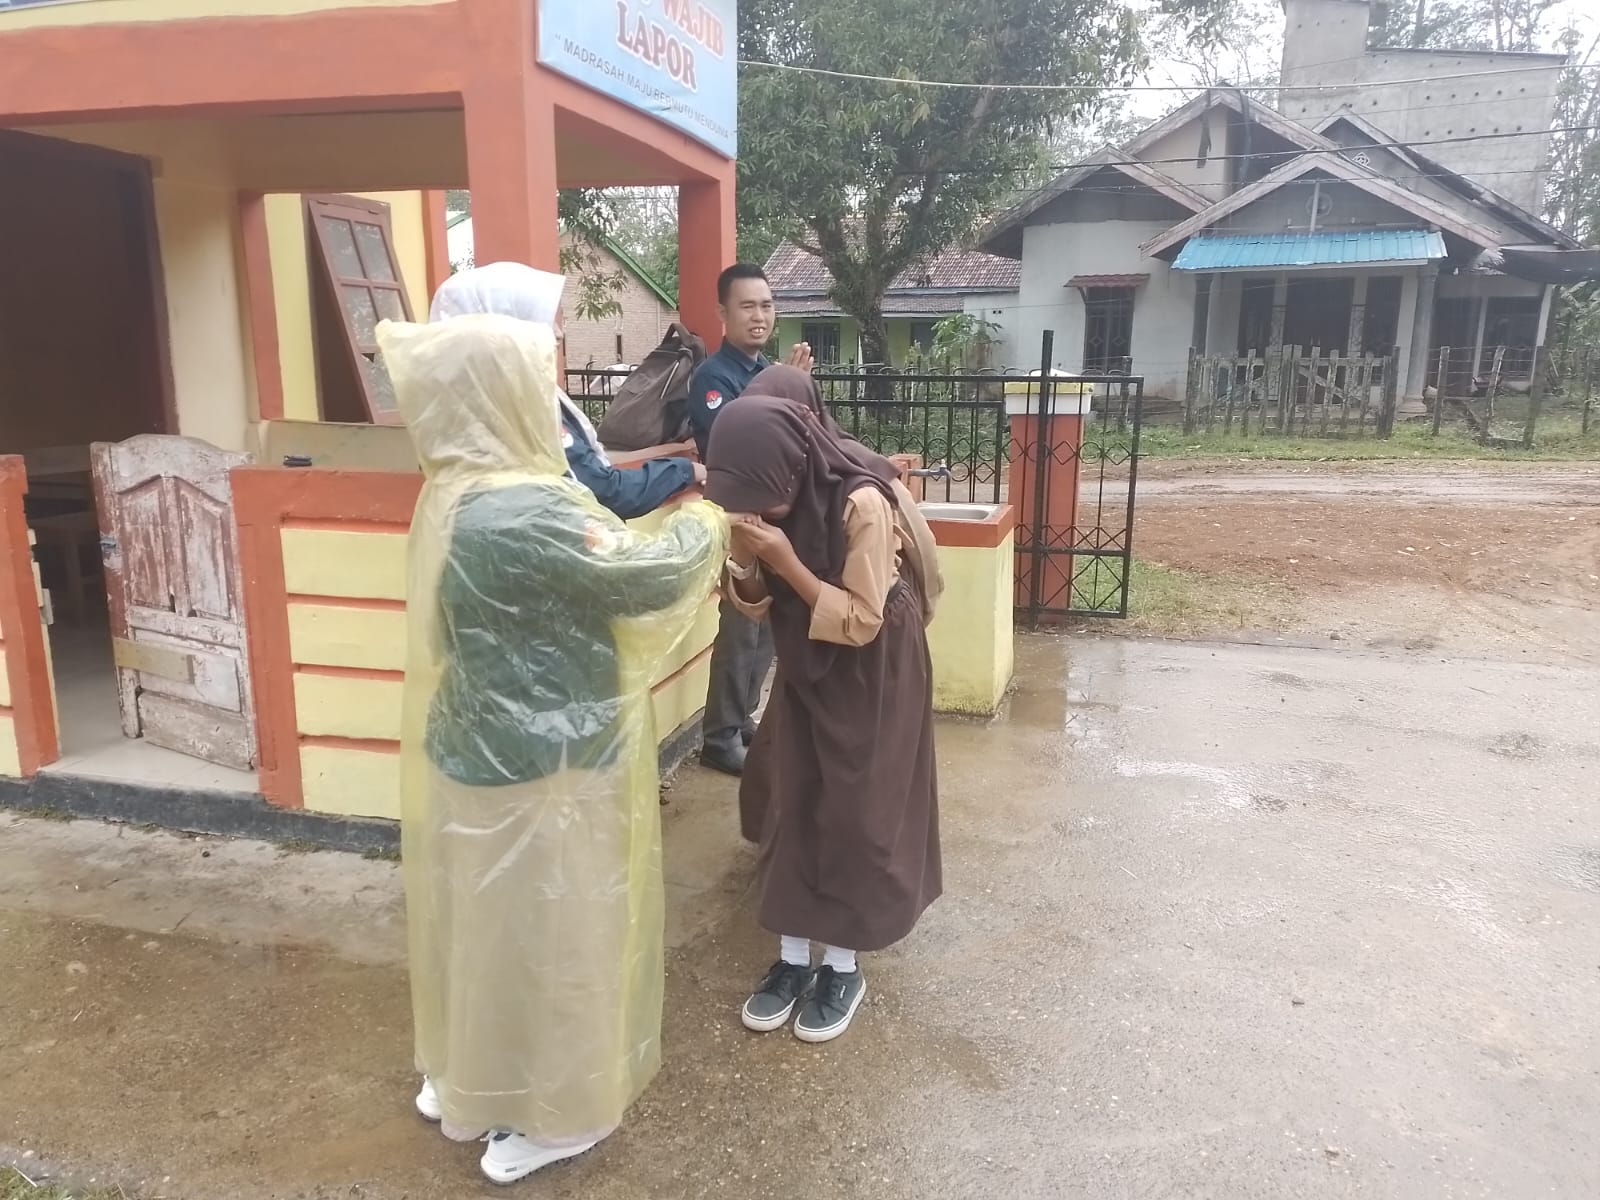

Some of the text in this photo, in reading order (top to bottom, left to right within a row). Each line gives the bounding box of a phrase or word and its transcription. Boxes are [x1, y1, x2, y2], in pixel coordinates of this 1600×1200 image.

[563, 37, 625, 82] MADRASAH
[626, 72, 653, 97] MAJU
[616, 1, 699, 90] LAPOR
